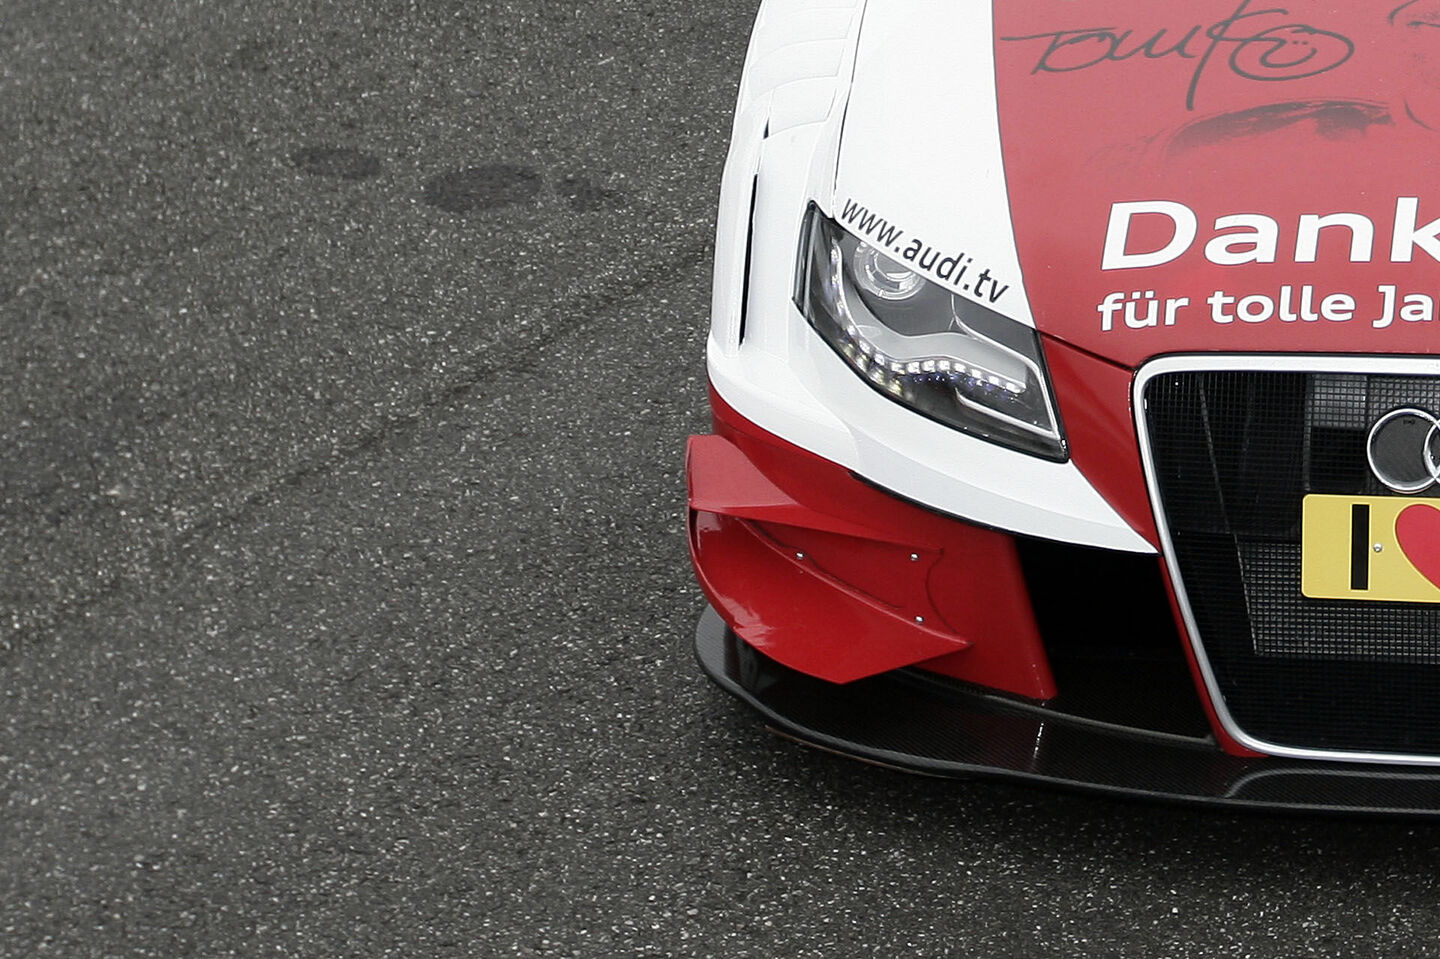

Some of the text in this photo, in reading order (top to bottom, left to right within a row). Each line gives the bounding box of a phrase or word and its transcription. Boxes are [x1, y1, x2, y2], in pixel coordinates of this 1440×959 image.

[840, 198, 1009, 304] www.audi.tv
[1097, 290, 1190, 331] für
[1206, 284, 1357, 323] tolle
[1350, 503, 1371, 591] I
